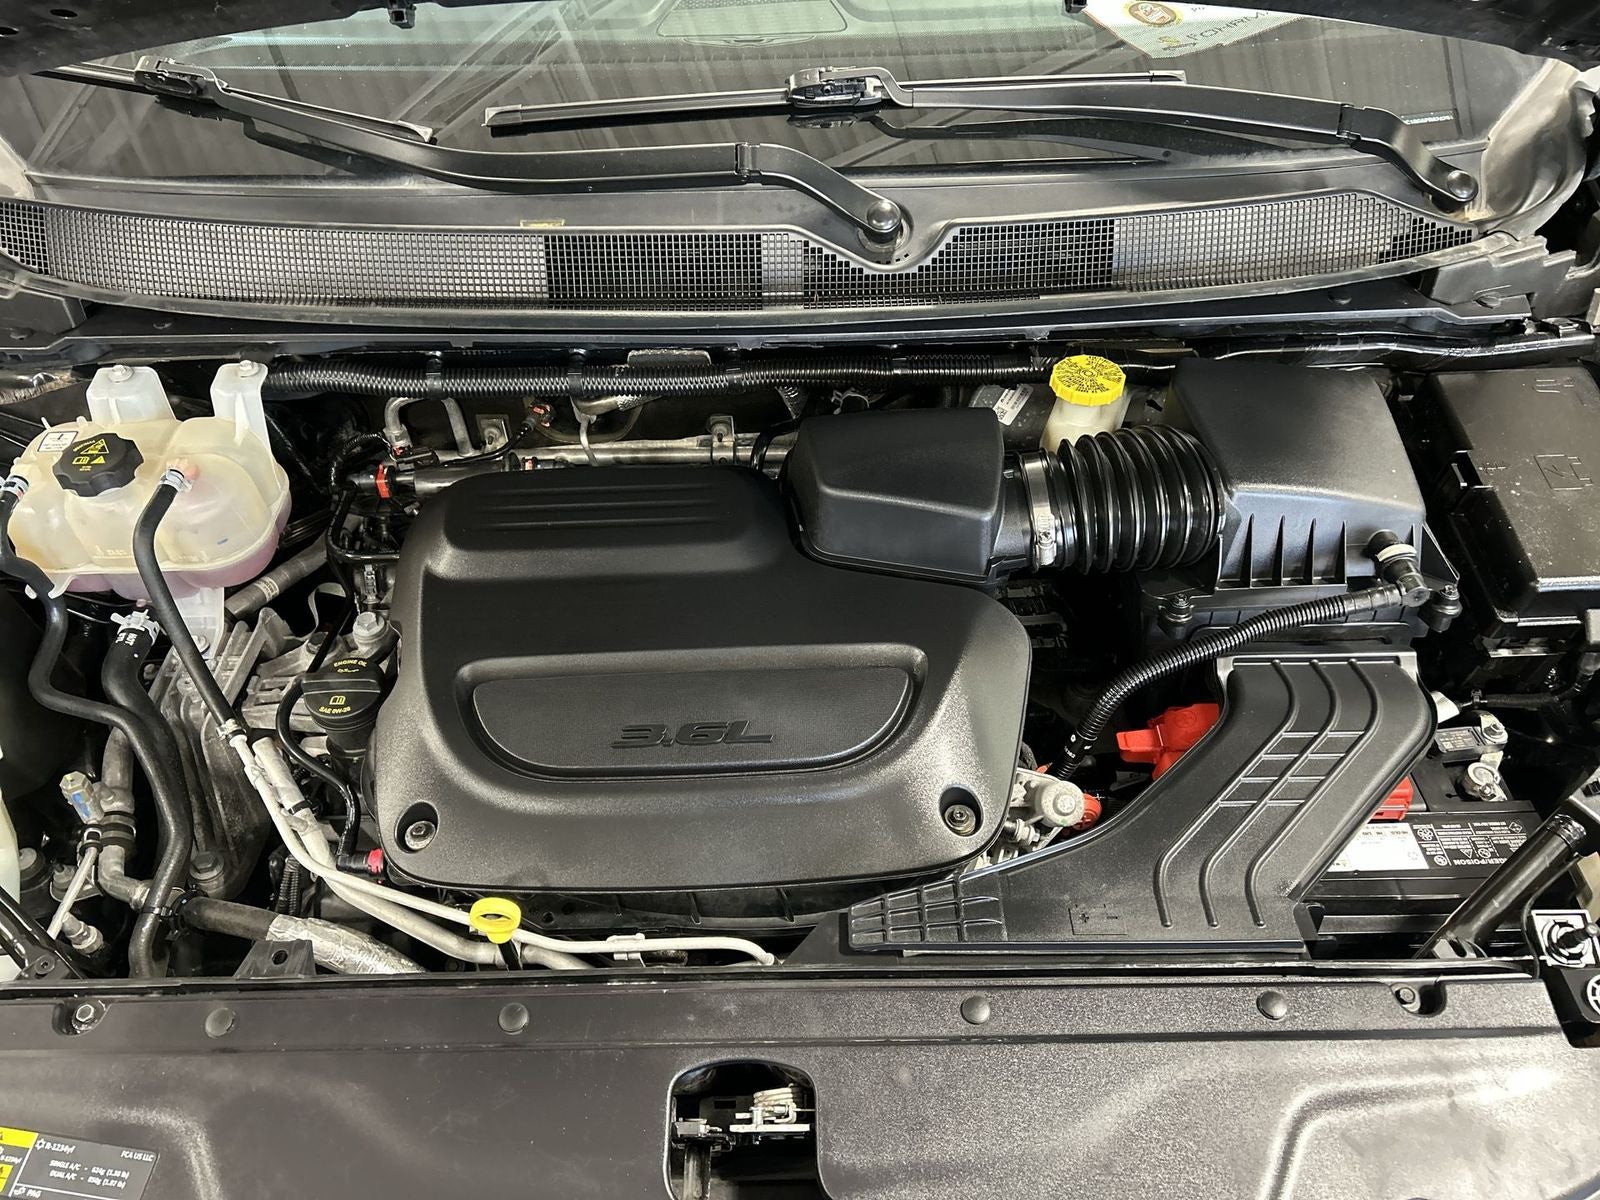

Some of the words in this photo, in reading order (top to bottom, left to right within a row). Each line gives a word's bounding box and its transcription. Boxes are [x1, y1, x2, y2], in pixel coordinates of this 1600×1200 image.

[333, 659, 358, 667] ENGINE
[610, 720, 774, 749] 3.6L
[120, 1150, 133, 1159] FCA
[133, 1151, 143, 1161] US
[142, 1153, 155, 1162] LLC
